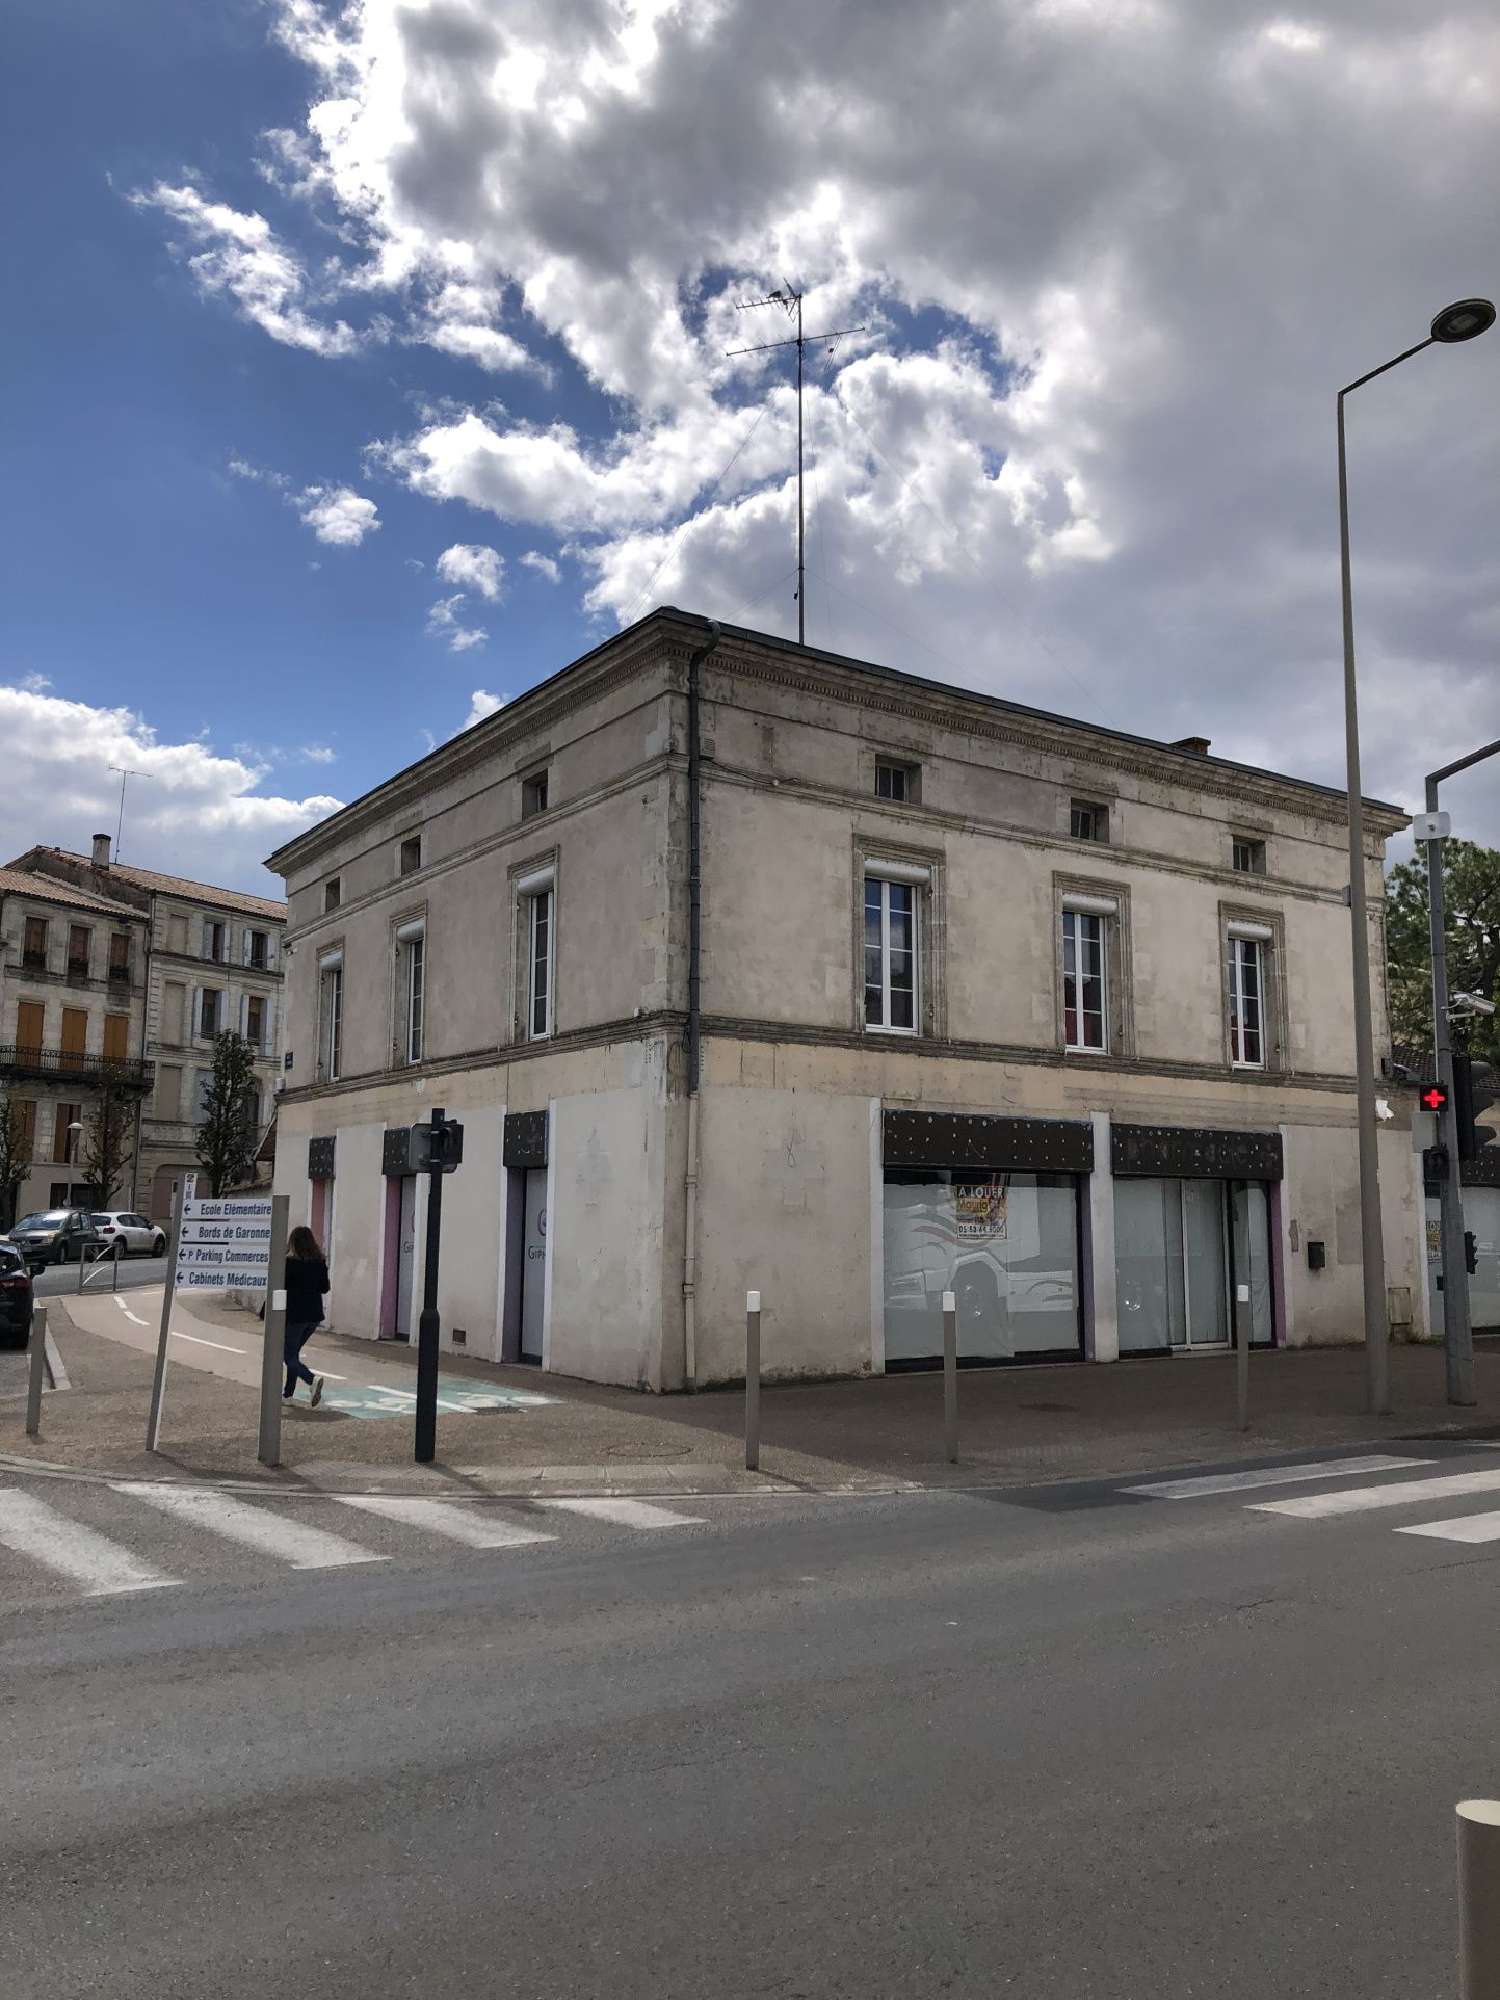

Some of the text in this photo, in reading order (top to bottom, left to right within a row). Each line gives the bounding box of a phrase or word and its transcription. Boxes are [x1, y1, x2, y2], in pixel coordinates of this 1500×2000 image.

[201, 1203, 221, 1215] Ecole
[198, 1226, 271, 1239] Bords de Garonne
[195, 1248, 223, 1264] Parking
[225, 1250, 269, 1263] Commerces
[189, 1271, 267, 1287] Cabinets Médicaux
